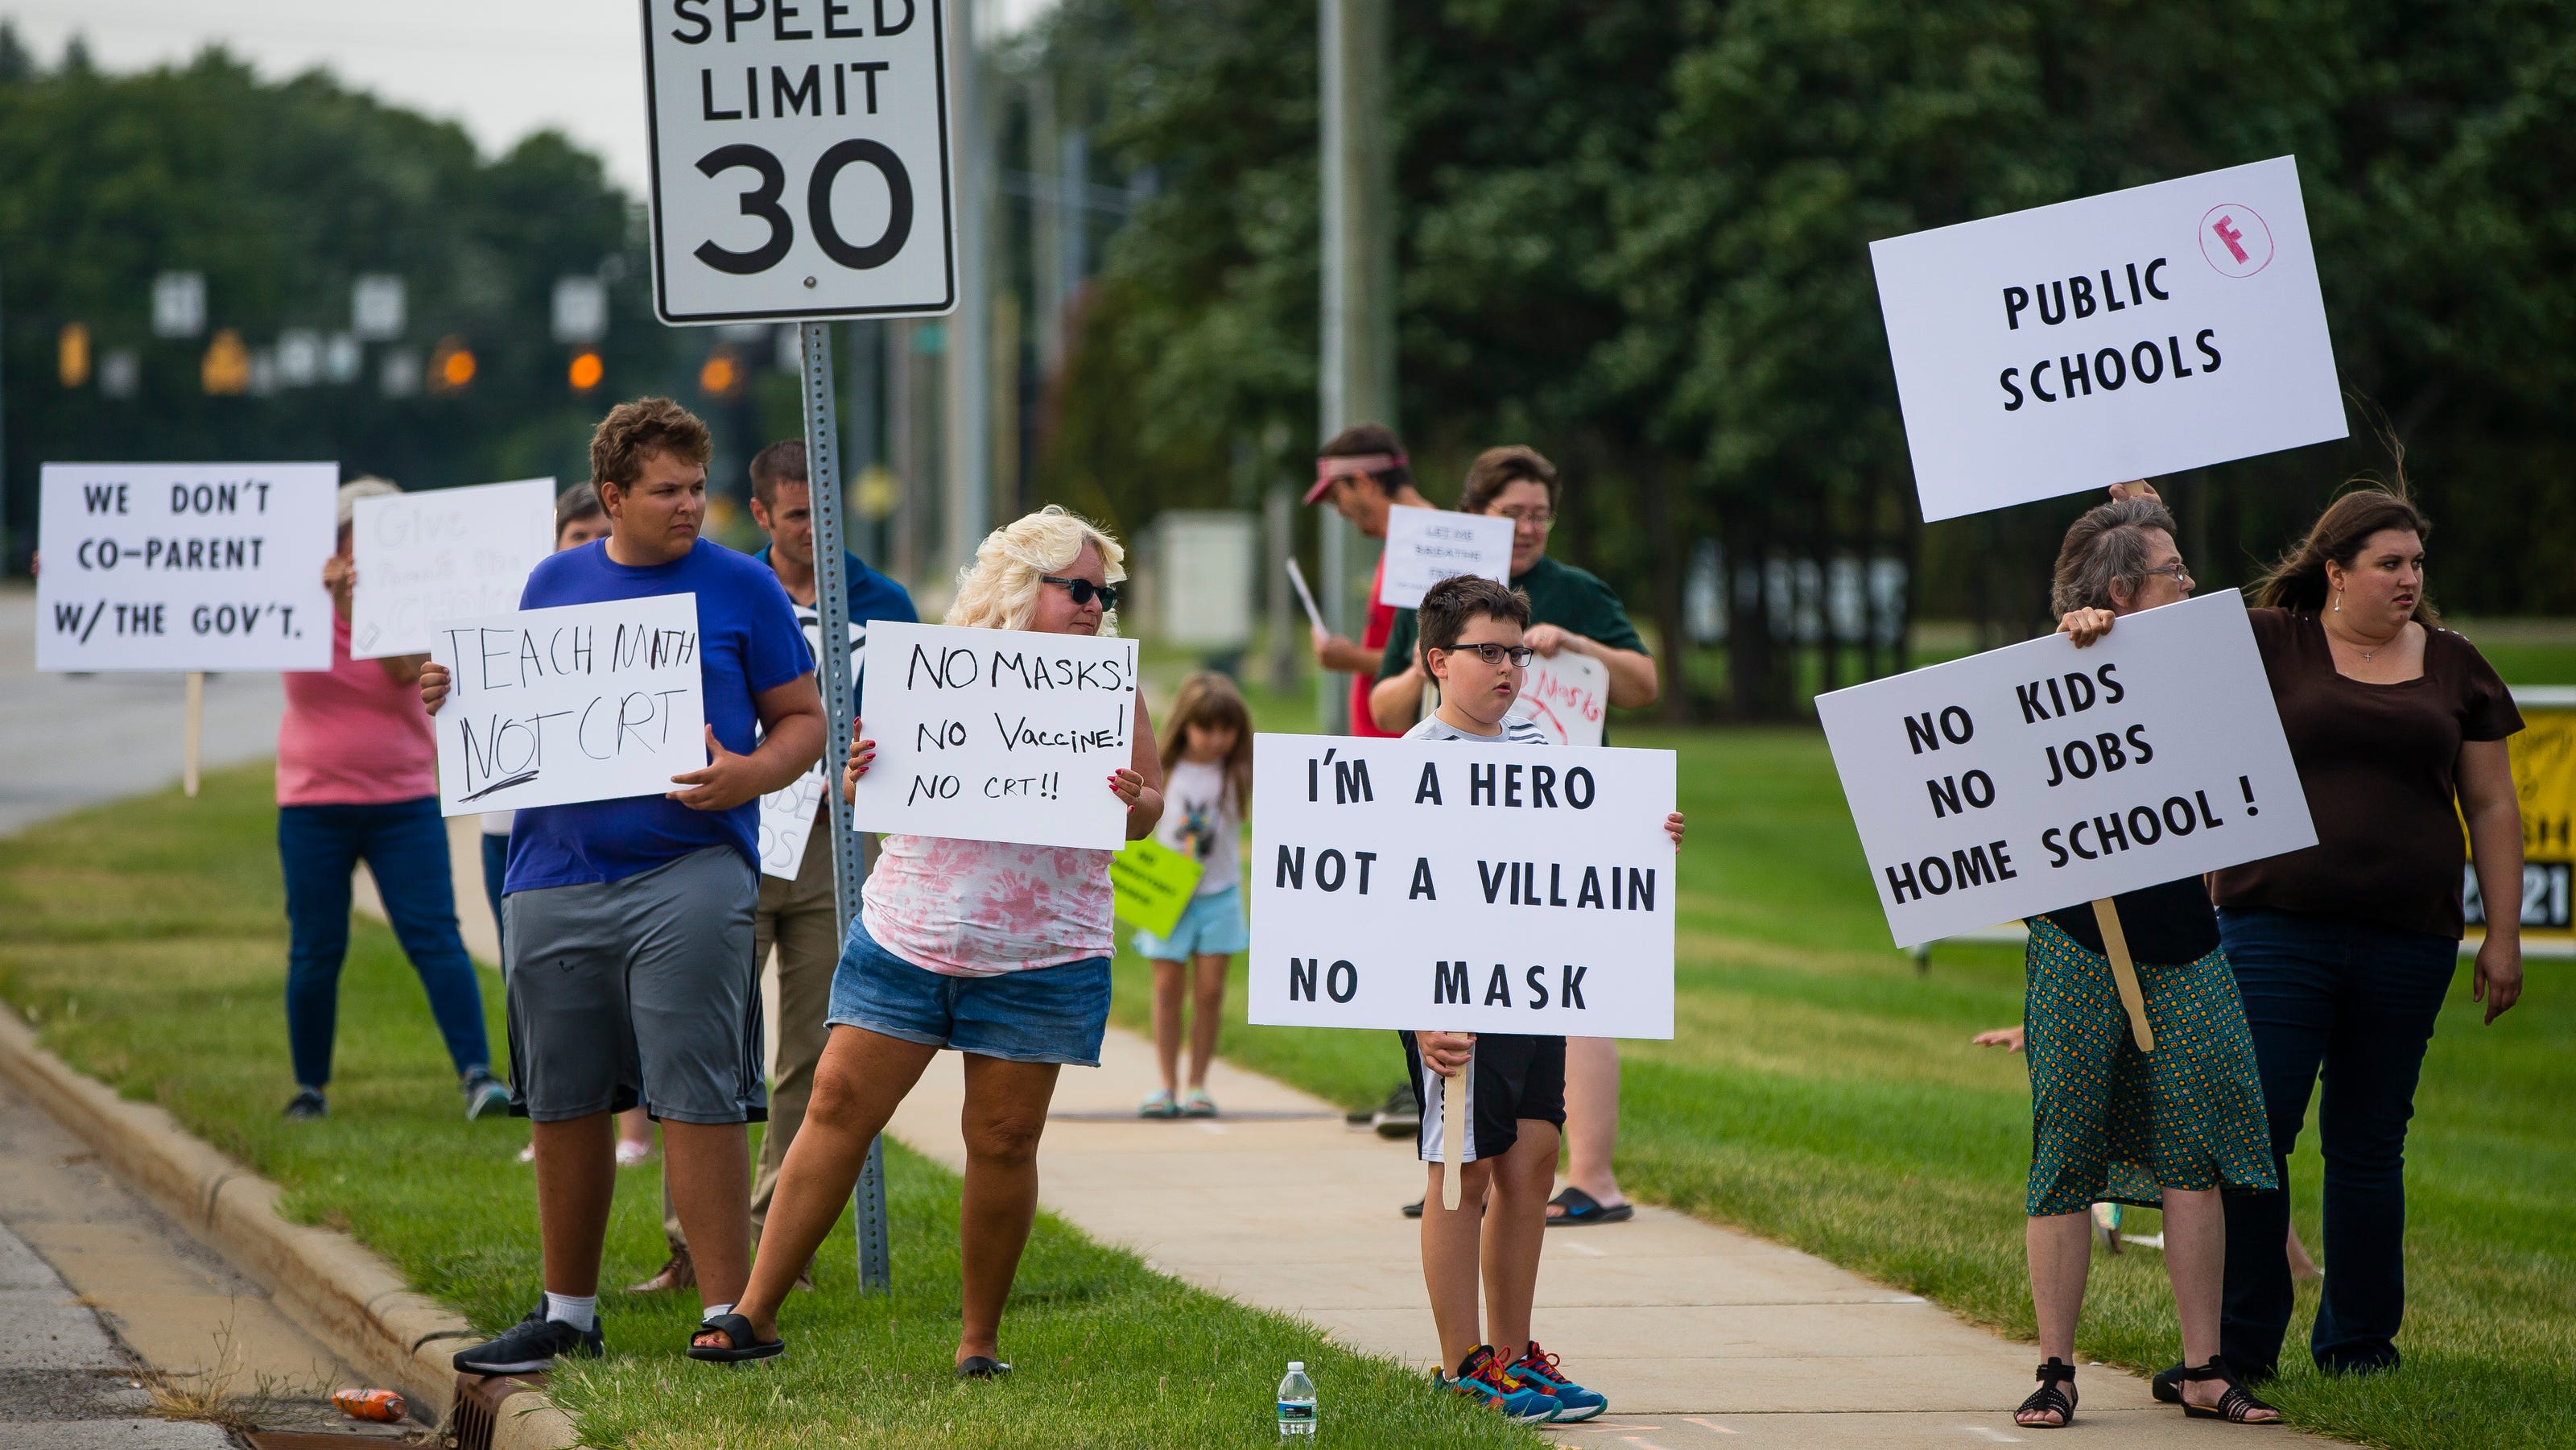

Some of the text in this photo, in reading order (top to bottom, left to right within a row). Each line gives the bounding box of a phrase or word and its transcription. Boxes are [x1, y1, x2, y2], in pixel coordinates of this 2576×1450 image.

[671, 0, 914, 44] SPEED
[701, 61, 889, 121] LIMIT
[693, 138, 914, 275] 30
[2213, 215, 2249, 264] F
[2004, 258, 2169, 330] PUBLIC
[2000, 329, 2221, 411] SCHOOLS
[85, 482, 269, 514] WE DON'T
[78, 539, 262, 569] CO-PARENT
[192, 604, 303, 638] GOV'T.
[442, 624, 695, 695] TEACH MATH
[908, 644, 977, 690] NO
[992, 646, 1133, 692] MASKS!
[918, 720, 966, 752] NO
[1904, 663, 2124, 754] NO KIDS
[460, 689, 687, 791] NOT CRT
[908, 772, 1058, 806] NO CRT!!
[1309, 749, 1595, 809] I'M A HERO
[1926, 725, 2153, 818] NO JOBS
[1885, 840, 2017, 904] HOME
[2042, 790, 2223, 868] SCHOOL
[1276, 845, 1655, 911] NOT A VILLAIN
[1290, 958, 1587, 1010] NO MASK
